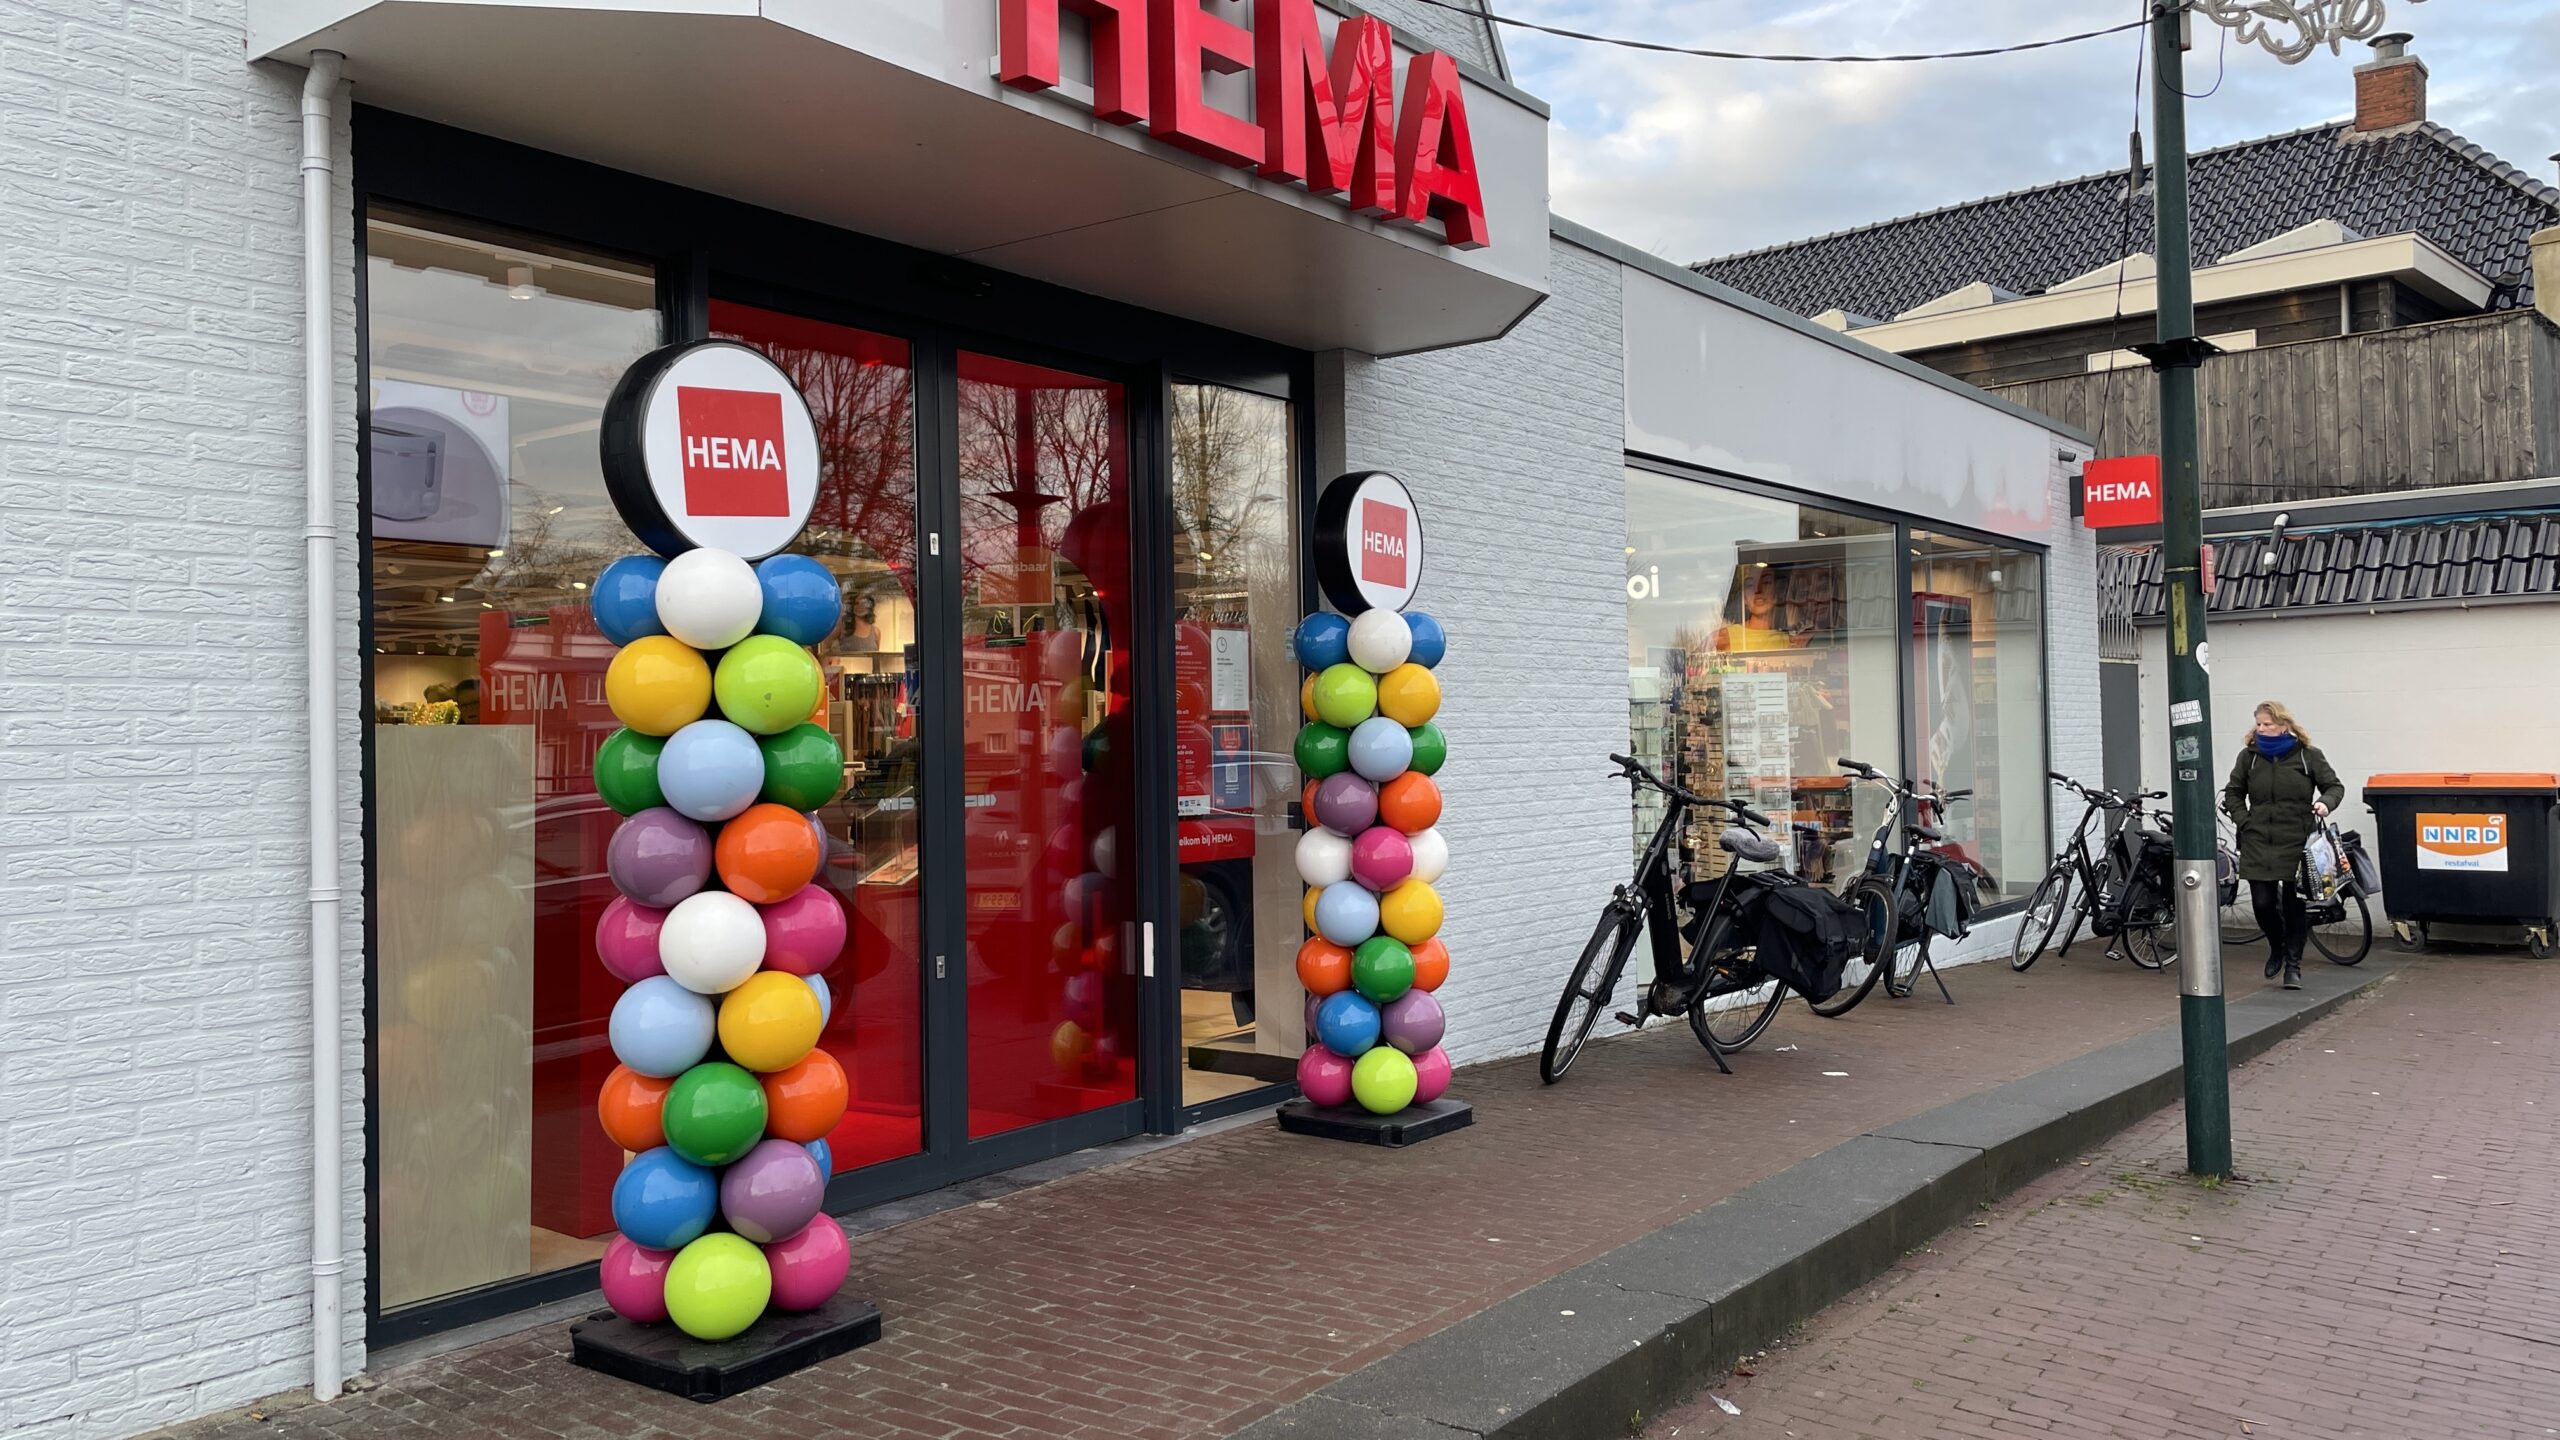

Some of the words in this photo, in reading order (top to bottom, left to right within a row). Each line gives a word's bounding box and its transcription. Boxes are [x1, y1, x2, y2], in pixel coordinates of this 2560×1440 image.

[687, 436, 782, 471] HEMA
[2087, 481, 2152, 502] HEMA
[1364, 529, 1405, 558] HEMA
[490, 673, 568, 711] HEMA
[967, 683, 1045, 713] HEMA
[1179, 837, 1200, 846] elkom
[1201, 835, 1211, 847] bij
[1212, 833, 1233, 843] HEMA
[2425, 828, 2498, 842] NNRD
[2445, 860, 2479, 868] restafval
